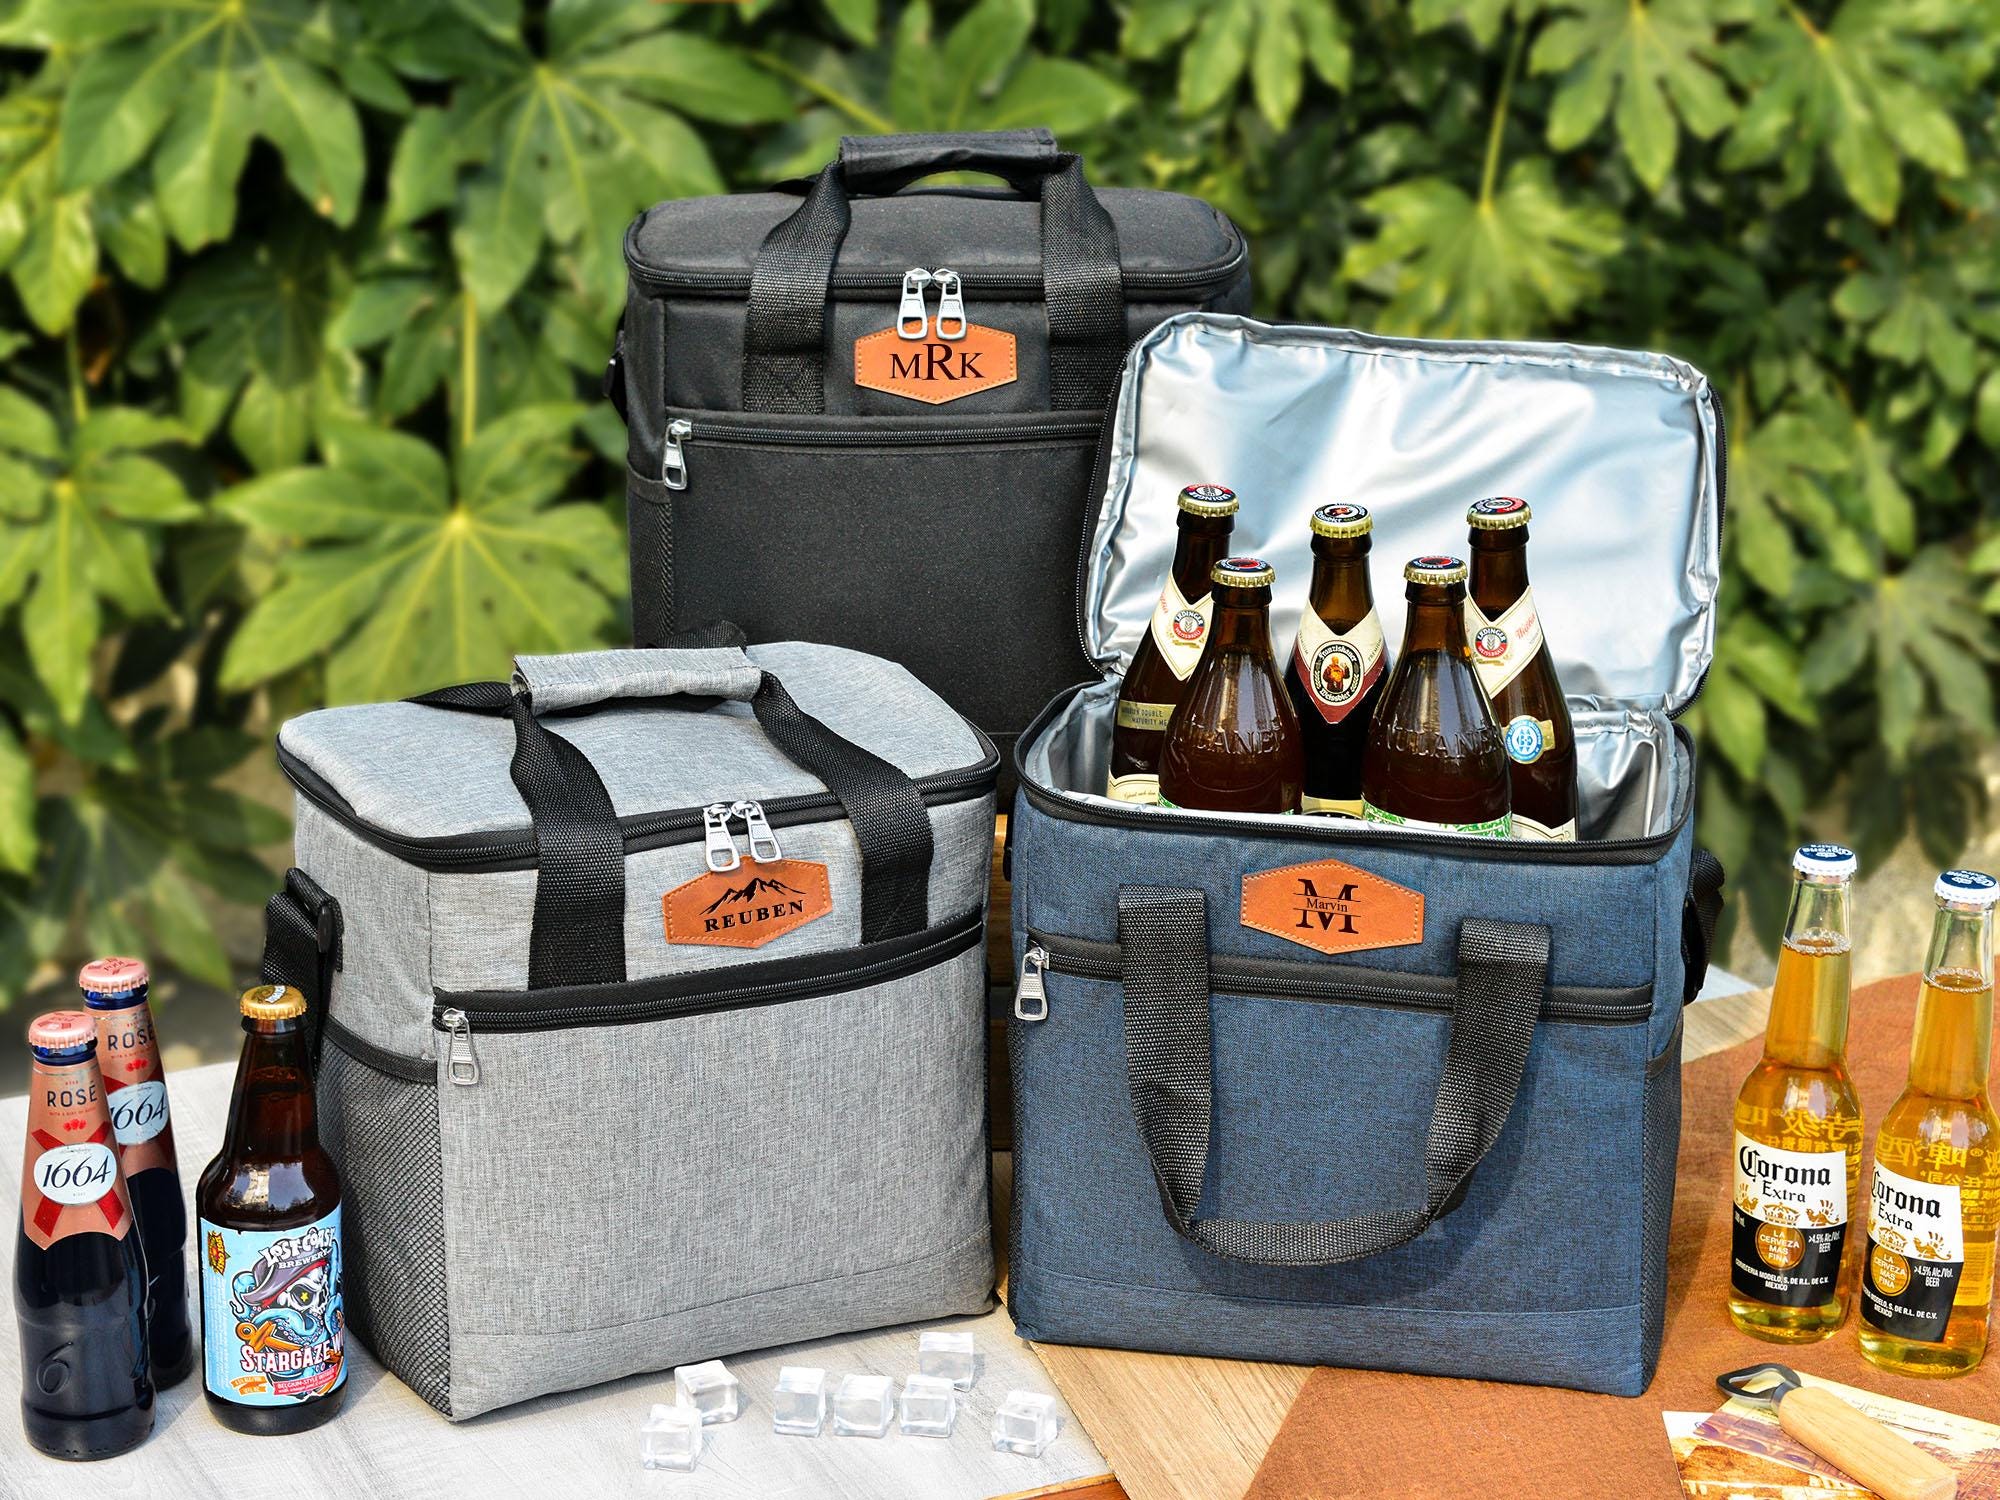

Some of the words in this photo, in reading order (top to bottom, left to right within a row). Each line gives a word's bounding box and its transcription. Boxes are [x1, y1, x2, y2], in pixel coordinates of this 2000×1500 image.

[889, 343, 985, 381] MRK
[1306, 896, 1349, 913] Marvin
[704, 899, 805, 933] REUBEN
[47, 1080, 98, 1108] ROSÉ
[42, 1155, 112, 1189] 1664
[1739, 1145, 1832, 1186] Corona
[1762, 1180, 1806, 1203] Extra
[1878, 1201, 1913, 1231] Extra
[1759, 1234, 1801, 1249] CERVEZA
[1773, 1230, 1786, 1238] LA
[278, 1246, 333, 1269] BREWERY
[1768, 1253, 1789, 1264] FINA
[1873, 1257, 1907, 1276] CERVEZA
[1883, 1254, 1895, 1264] LA
[1765, 1280, 1788, 1291] MEXICO
[1878, 1277, 1895, 1289] FINA
[1924, 1276, 1940, 1287] BEER
[1894, 1305, 1904, 1314] DE
[1916, 1310, 1926, 1318] DE
